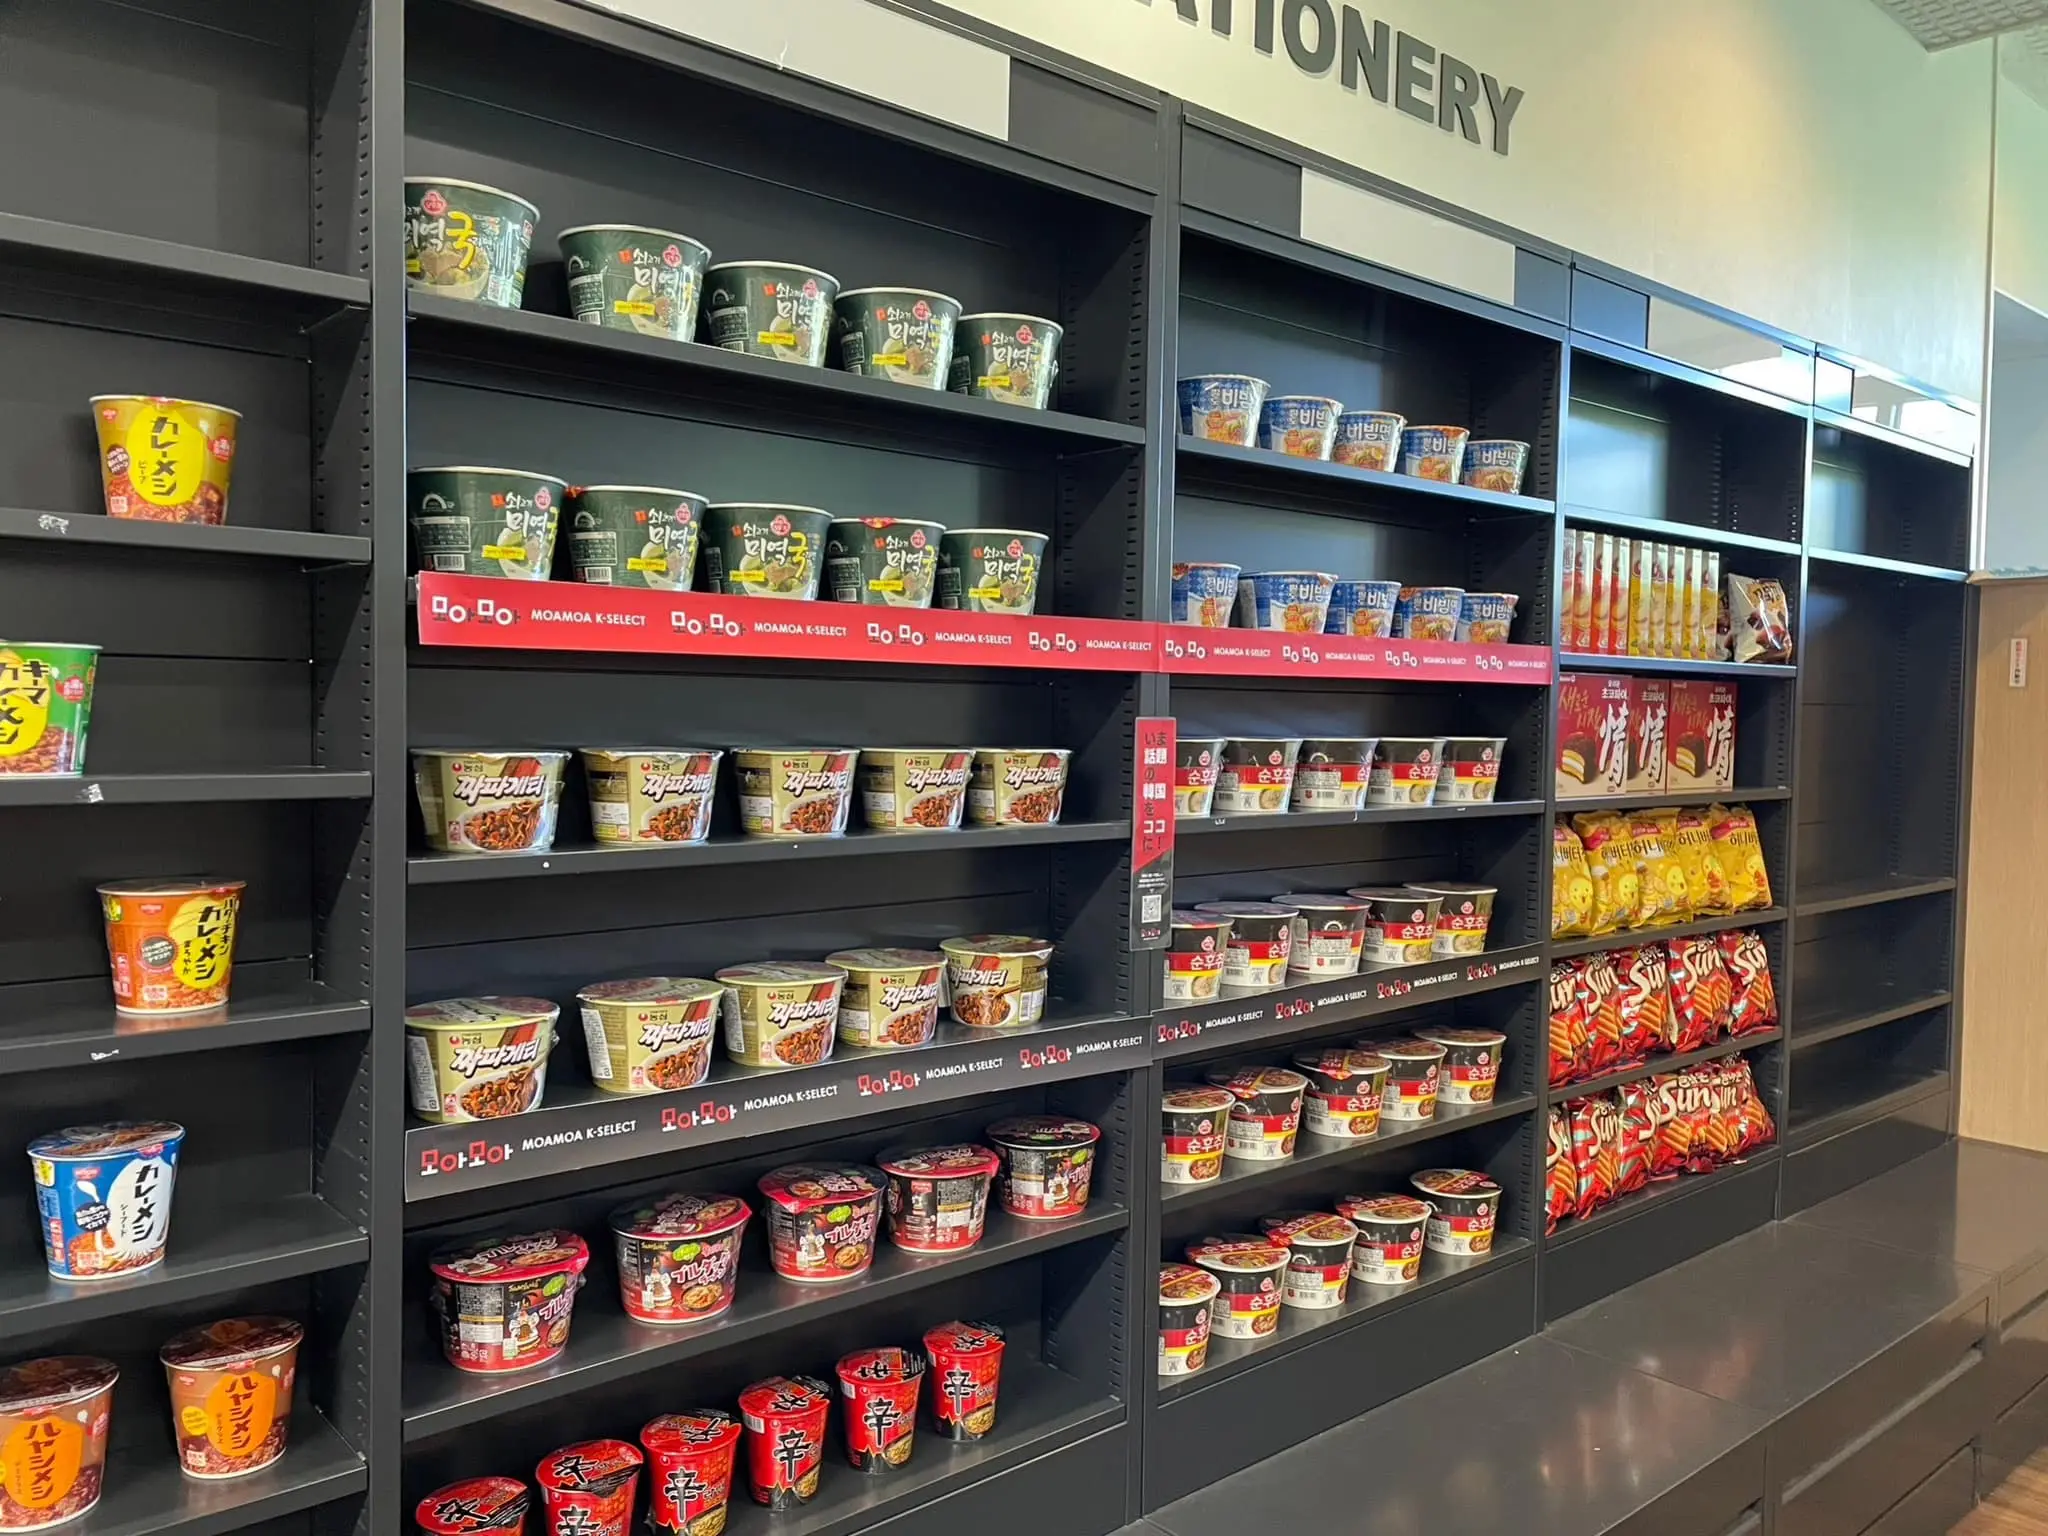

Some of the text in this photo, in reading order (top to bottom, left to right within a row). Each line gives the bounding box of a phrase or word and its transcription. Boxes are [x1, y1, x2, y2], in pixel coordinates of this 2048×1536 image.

[1172, 0, 1525, 156] IONERY
[150, 416, 179, 497] カレーメシ
[743, 531, 809, 579] 미역국
[983, 553, 1035, 596] 미역국
[531, 609, 647, 627] MOAMOA K-SELECT
[754, 621, 848, 638] MOAMOA K-SELECT
[935, 631, 1013, 645] MOAMOA K-SELECT
[1086, 639, 1152, 652] MOAMOA K-SELECT
[1213, 646, 1244, 657] MOAMOA
[22, 660, 50, 705] キーマ
[453, 774, 546, 807] 짜파게티
[640, 772, 713, 804] 짜파게티
[783, 770, 850, 798] 짜파게티
[905, 767, 965, 793] 짜파게티
[1143, 819, 1166, 834] ココ
[195, 905, 220, 981] カレーメシ
[1682, 945, 1724, 993] Sun
[880, 984, 939, 1008] 짜파게티
[1584, 964, 1619, 1016] Sun
[768, 998, 837, 1028] 짜파게티
[1205, 1010, 1264, 1028] MOAMOA K-SELECT
[639, 1017, 712, 1051] 짜파게티
[1076, 1036, 1143, 1055] MOAMOA K-SELECT
[450, 1038, 541, 1079] 짜파게티
[926, 1057, 1004, 1079] MOAMOA K-SELECT
[1020, 1045, 1072, 1069] 모아모아
[744, 1085, 839, 1112] MOAMOA K-SELECT
[858, 1070, 921, 1096] 모아모아
[661, 1100, 737, 1132] 모아모아
[1659, 1078, 1712, 1126] Sun
[522, 1120, 637, 1151] MOAMOA K-SELECT
[421, 1139, 514, 1176] 모아모아
[132, 1164, 159, 1243] カレーメシ
[943, 1367, 979, 1416] 辛
[225, 1376, 259, 1450] ハヤシメシ
[864, 1398, 901, 1449] 辛
[24, 1422, 61, 1501] ハヤシメシ
[774, 1429, 814, 1484] 辛
[664, 1466, 707, 1524] 辛
